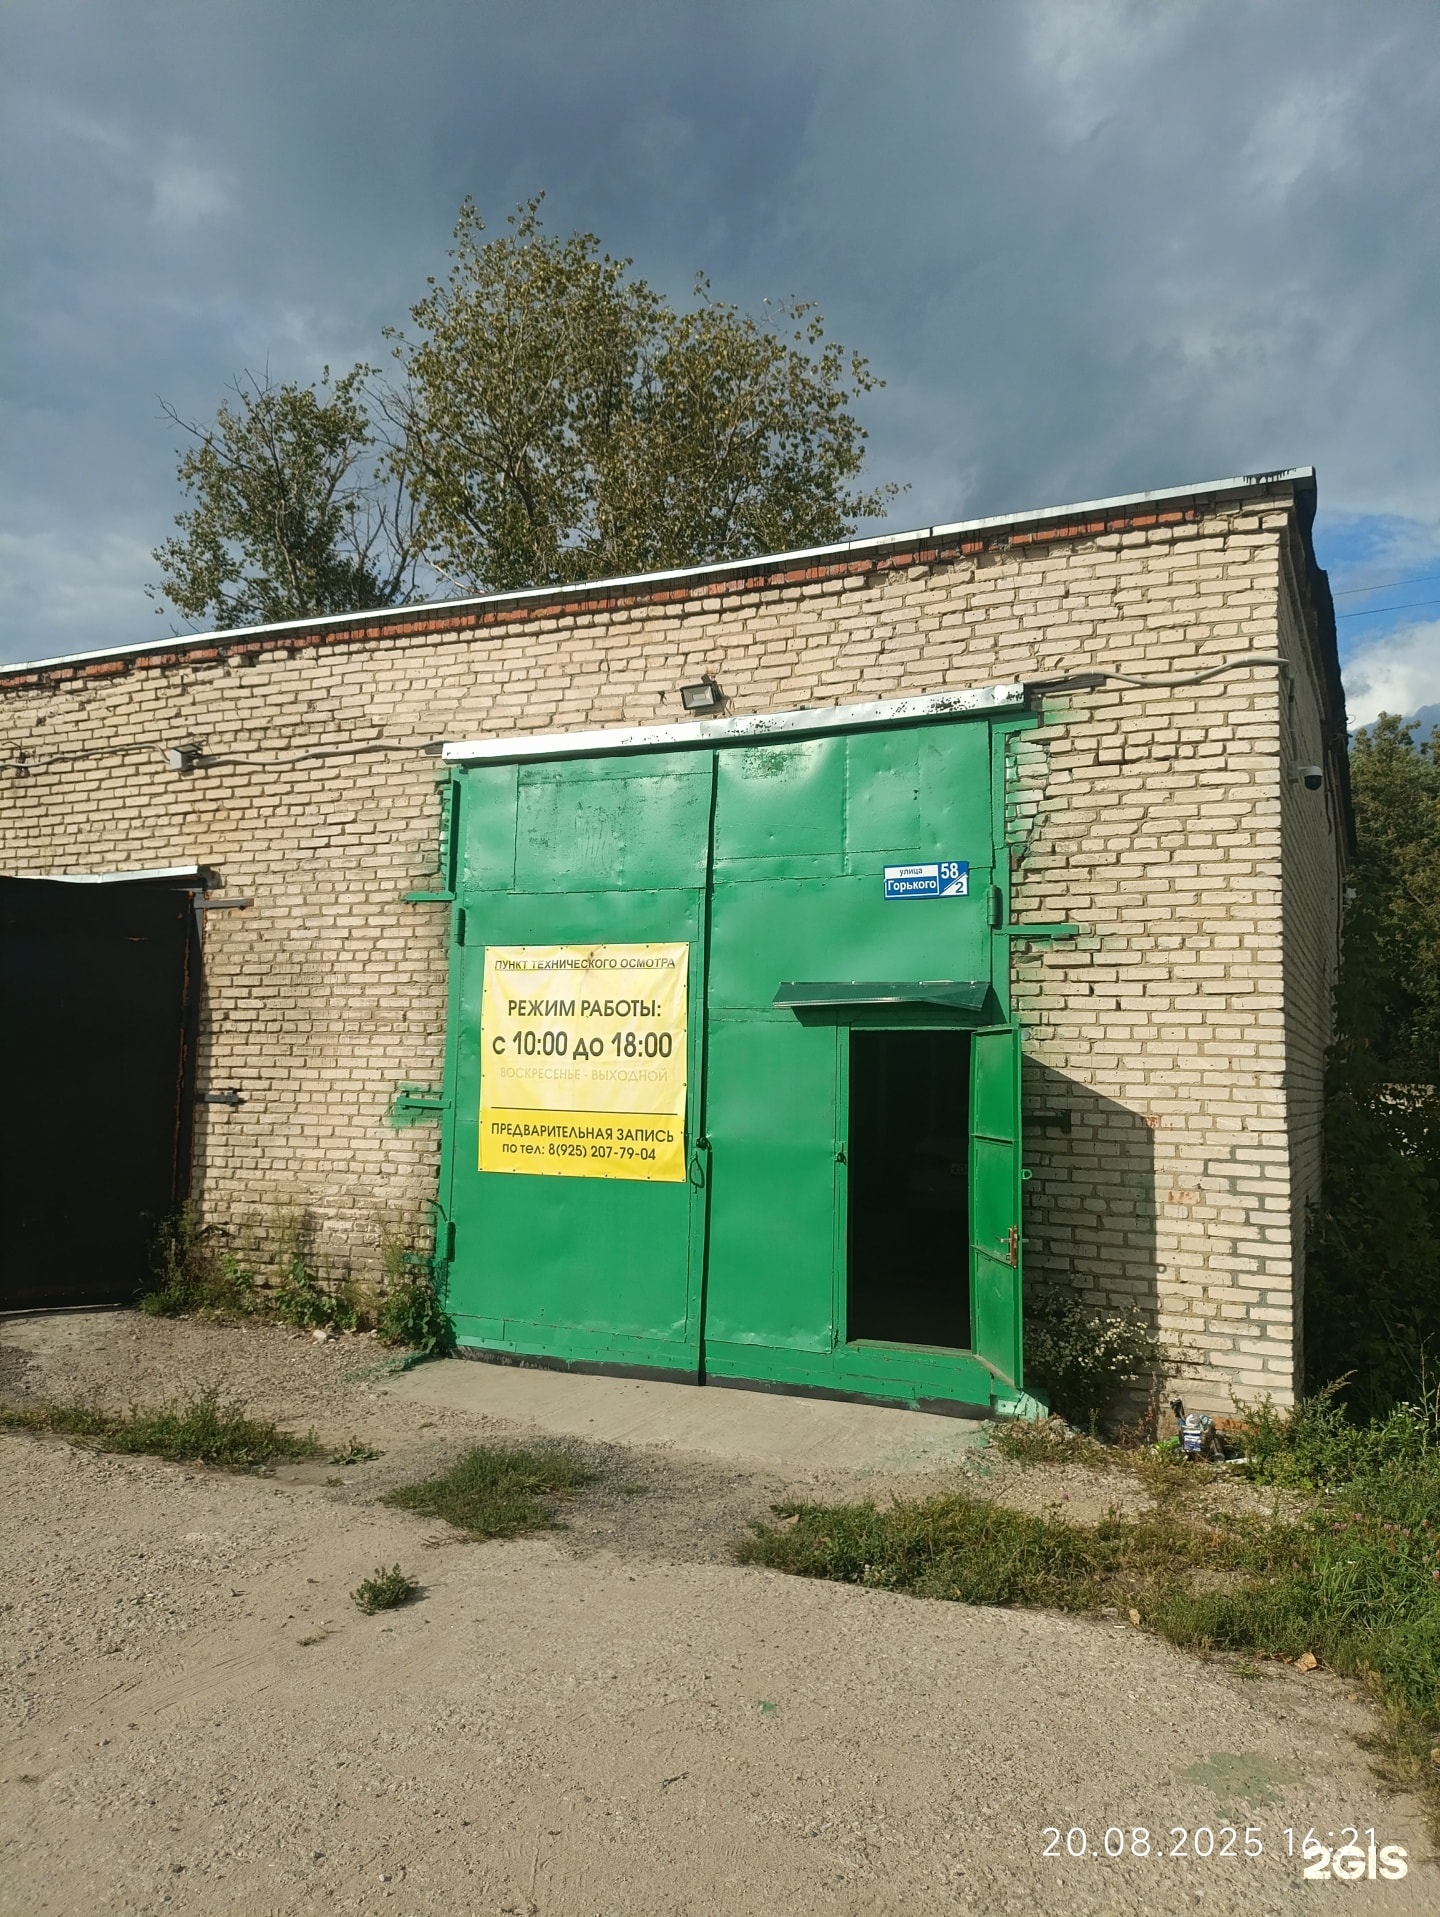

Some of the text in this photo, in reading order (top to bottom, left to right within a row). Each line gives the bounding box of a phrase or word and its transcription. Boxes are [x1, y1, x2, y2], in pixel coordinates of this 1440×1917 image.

[899, 867, 923, 877] улица
[940, 862, 959, 879] 58
[887, 880, 936, 892] Горького
[955, 881, 964, 893] 2
[495, 957, 675, 970] ПУНКТ ТЕХНИЧЕСКОГО ОСМОТРА
[508, 1000, 661, 1017] РЕЖИМ РАБОТЫ:
[512, 1030, 568, 1056] 10:00
[572, 1037, 604, 1060] до
[611, 1031, 673, 1058] 18:00
[500, 1067, 580, 1080] ВОСКРЕСЕНЬЕ
[591, 1068, 668, 1083] ВЫХОДНОЙ
[491, 1122, 674, 1142] ПРЕДВАРИТЕЛЬНАЯ ЗАПИСЬ
[502, 1143, 656, 1161] по тел: 8(925) 207-79-04
